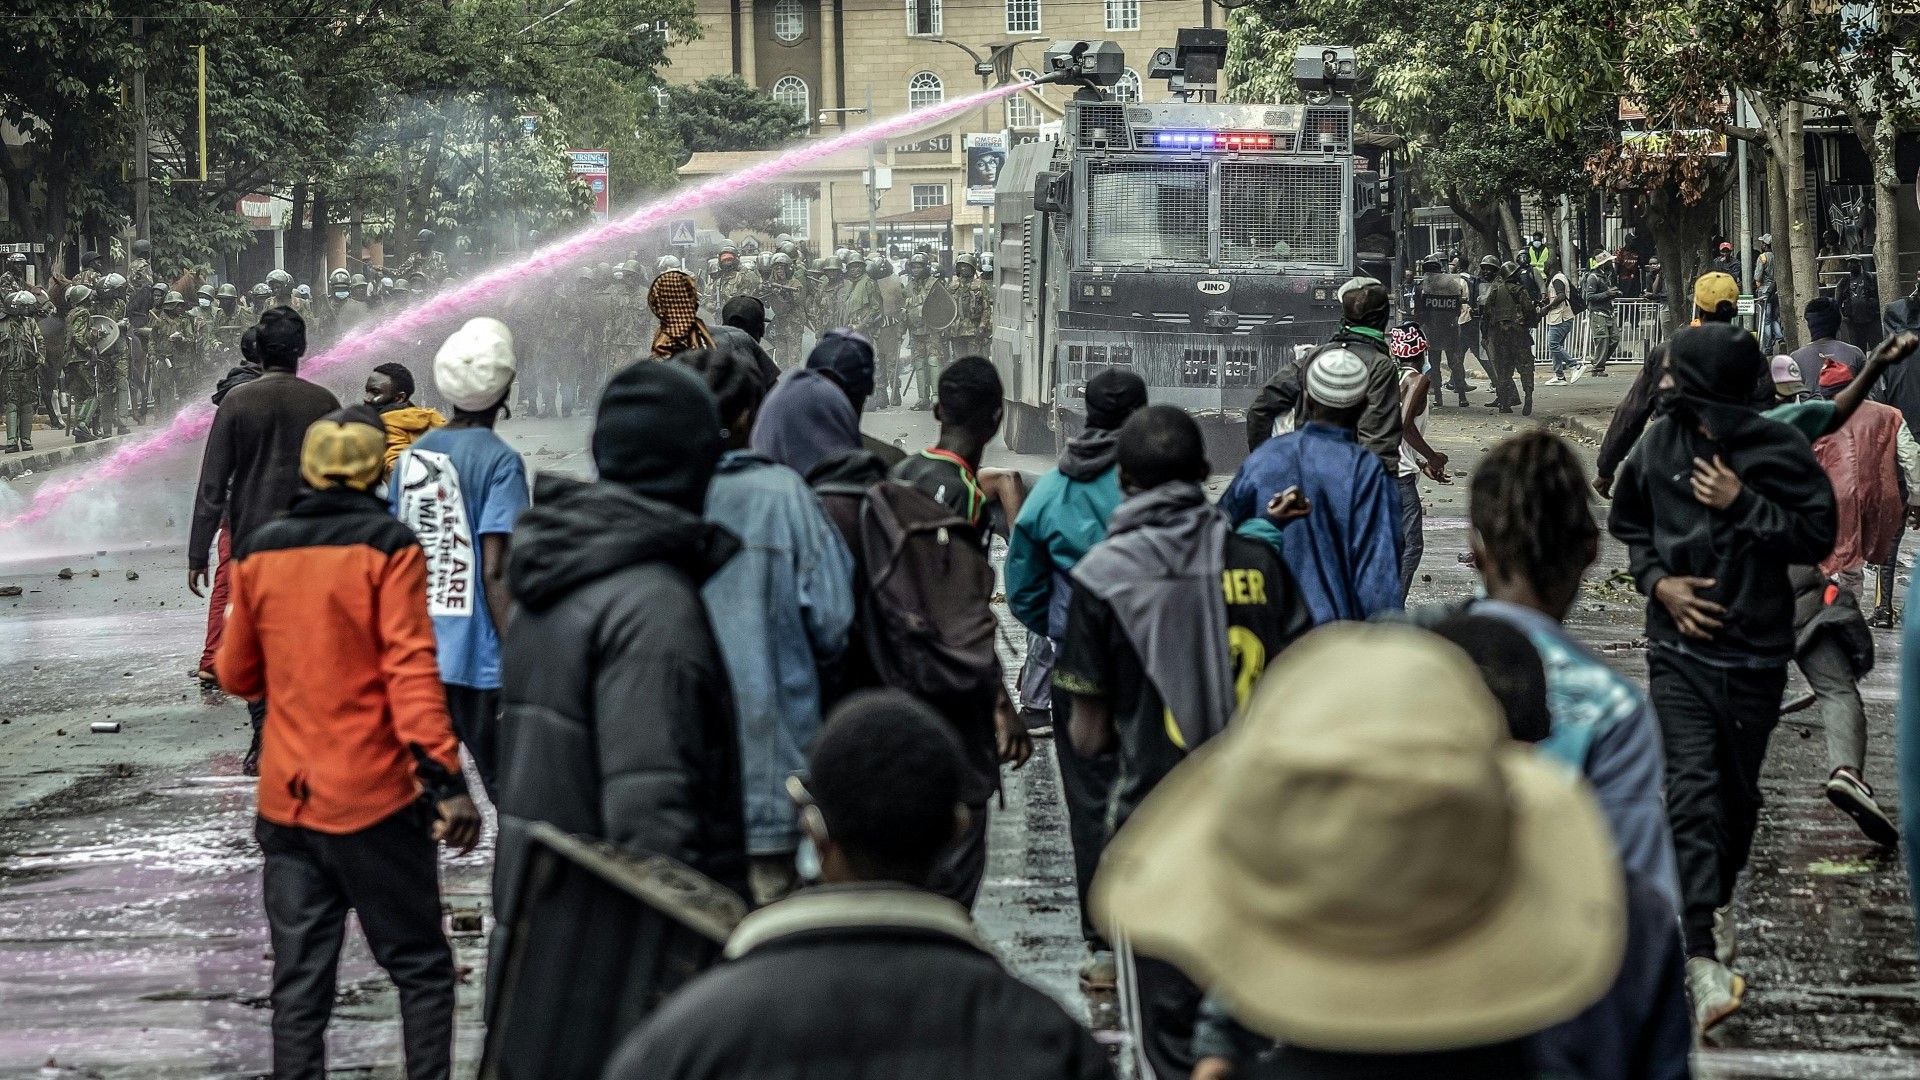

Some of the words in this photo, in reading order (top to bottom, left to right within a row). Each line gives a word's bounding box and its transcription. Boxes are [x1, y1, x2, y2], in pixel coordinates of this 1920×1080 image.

[574, 153, 601, 161] URSING
[1203, 283, 1225, 291] JINO
[1425, 298, 1457, 308] POLICE
[440, 538, 450, 565] THE
[435, 569, 449, 604] NEW
[447, 558, 468, 608] ARE
